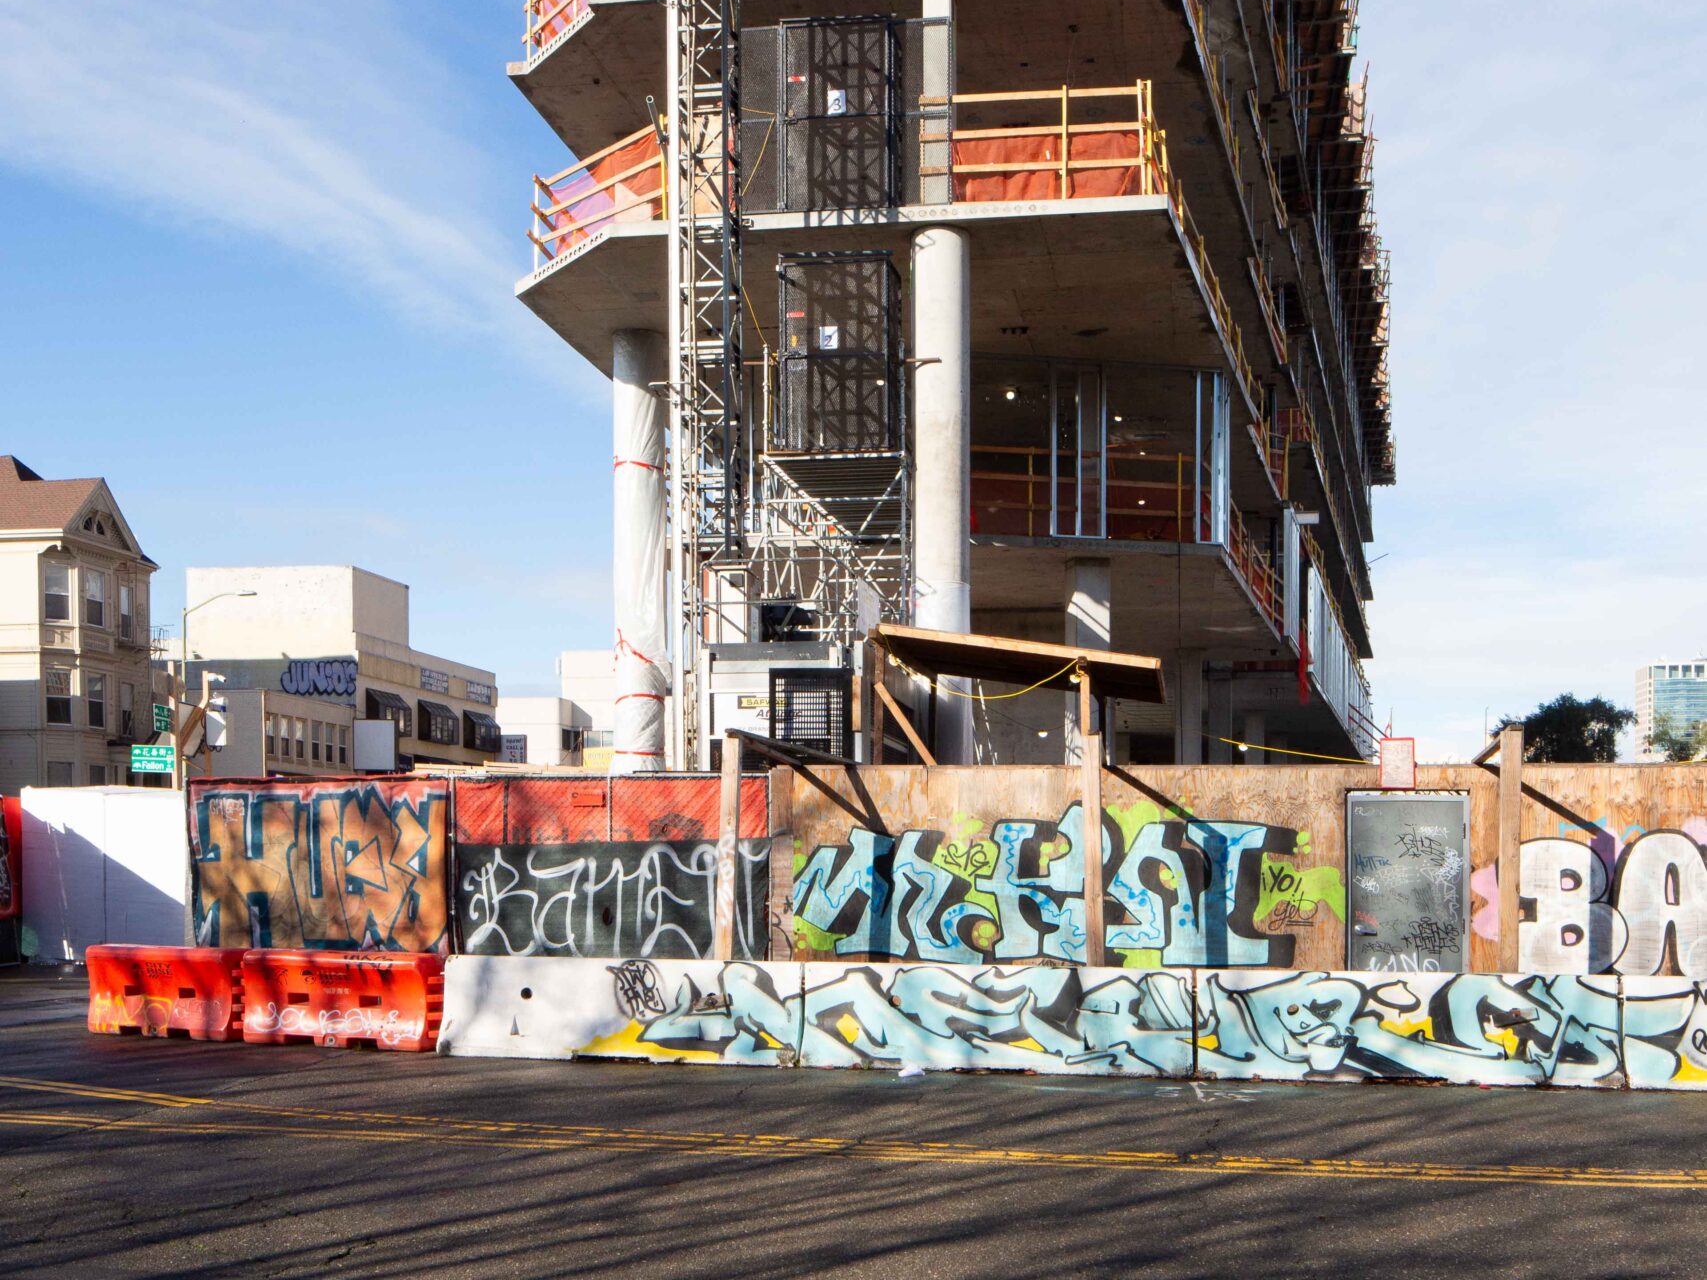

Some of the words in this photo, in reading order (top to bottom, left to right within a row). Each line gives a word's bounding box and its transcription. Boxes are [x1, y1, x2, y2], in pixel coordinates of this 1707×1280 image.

[833, 98, 842, 111] 3
[824, 335, 833, 347] 2
[142, 761, 165, 770] Fallon
